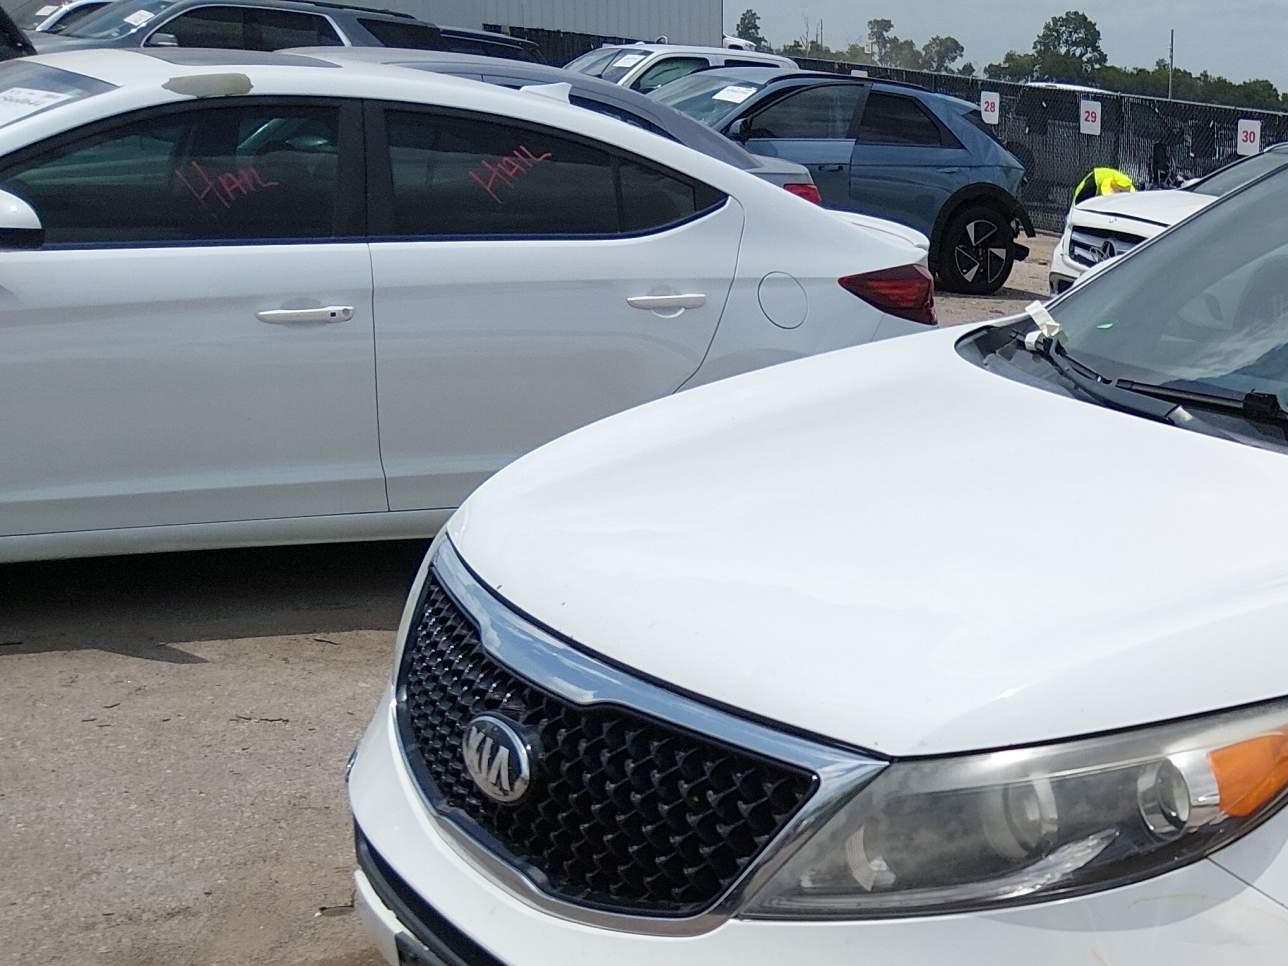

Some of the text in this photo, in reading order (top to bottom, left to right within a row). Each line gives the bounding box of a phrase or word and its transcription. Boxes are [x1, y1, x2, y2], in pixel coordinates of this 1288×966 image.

[983, 100, 996, 113] 28
[1084, 111, 1097, 123] 29
[1241, 131, 1256, 144] 30
[466, 725, 511, 793] KIA
